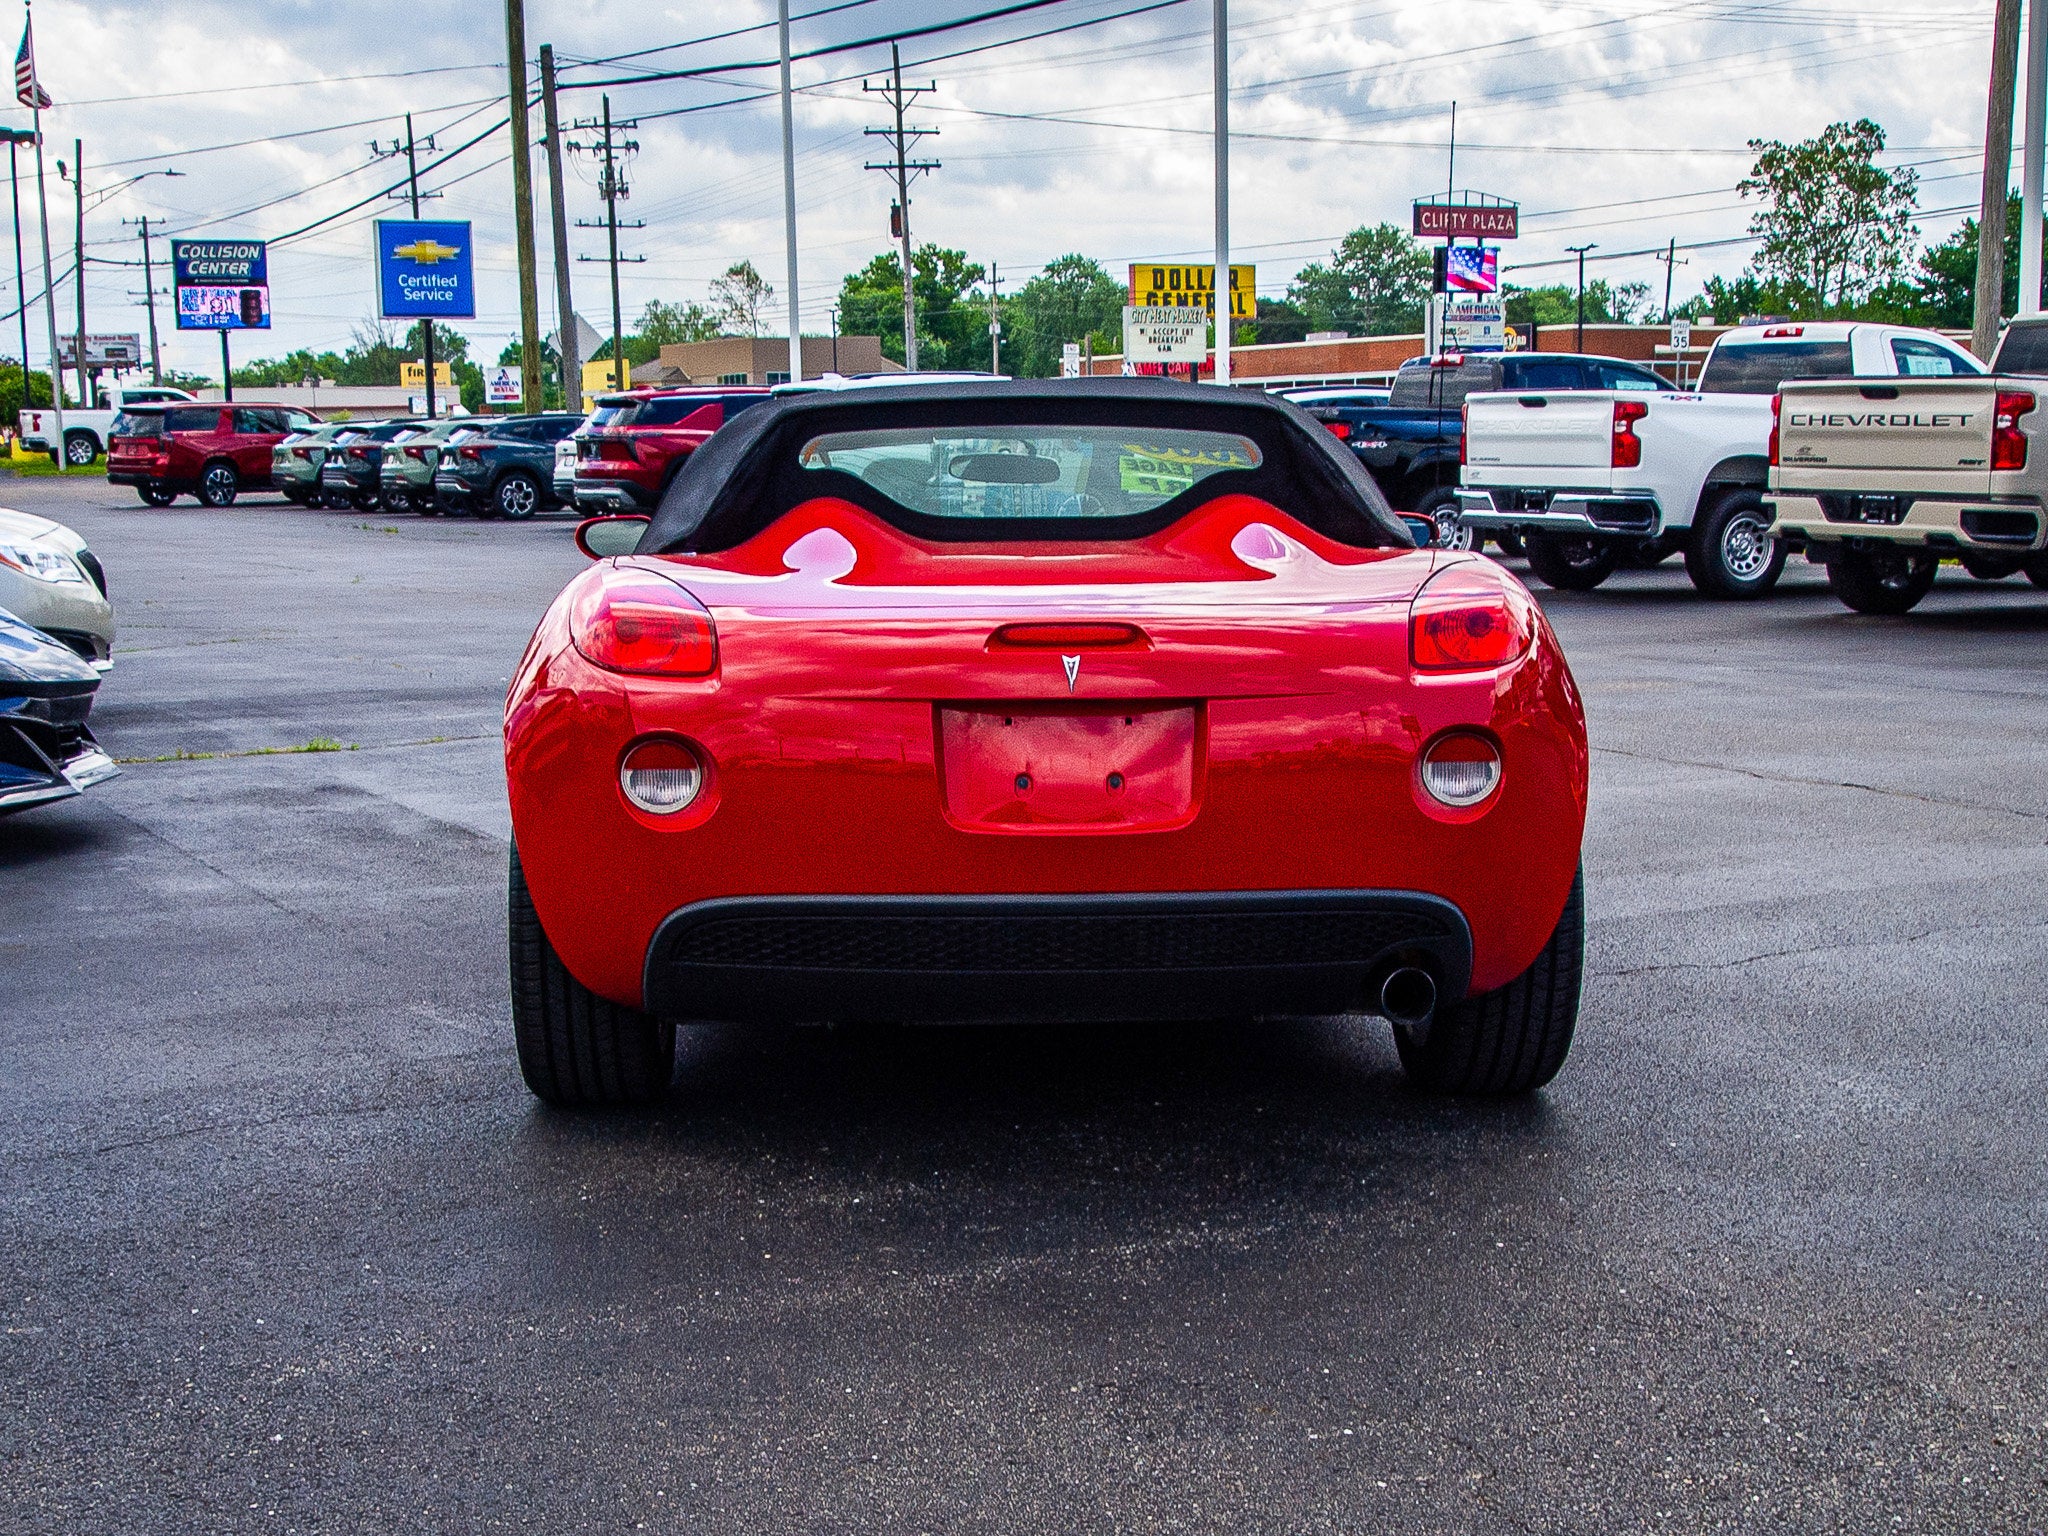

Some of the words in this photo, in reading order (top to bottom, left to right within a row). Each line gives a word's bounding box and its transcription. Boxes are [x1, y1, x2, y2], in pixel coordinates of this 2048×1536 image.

[1473, 213, 1514, 230] PLAZA
[178, 244, 260, 259] COLLISION
[187, 261, 250, 275] CENTER
[398, 274, 458, 287] Certified
[404, 288, 454, 301] Service
[1456, 304, 1500, 314] AMERICAN
[1132, 308, 1149, 324] CITY
[1140, 328, 1147, 336] W
[1153, 328, 1179, 336] ACCEPT
[1148, 336, 1187, 344] BREAKFAST
[1673, 336, 1688, 348] 35
[1137, 361, 1191, 375] AMERCAN
[1472, 419, 1598, 433] CHEVROLET
[1790, 414, 1974, 427] CHEVROLET
